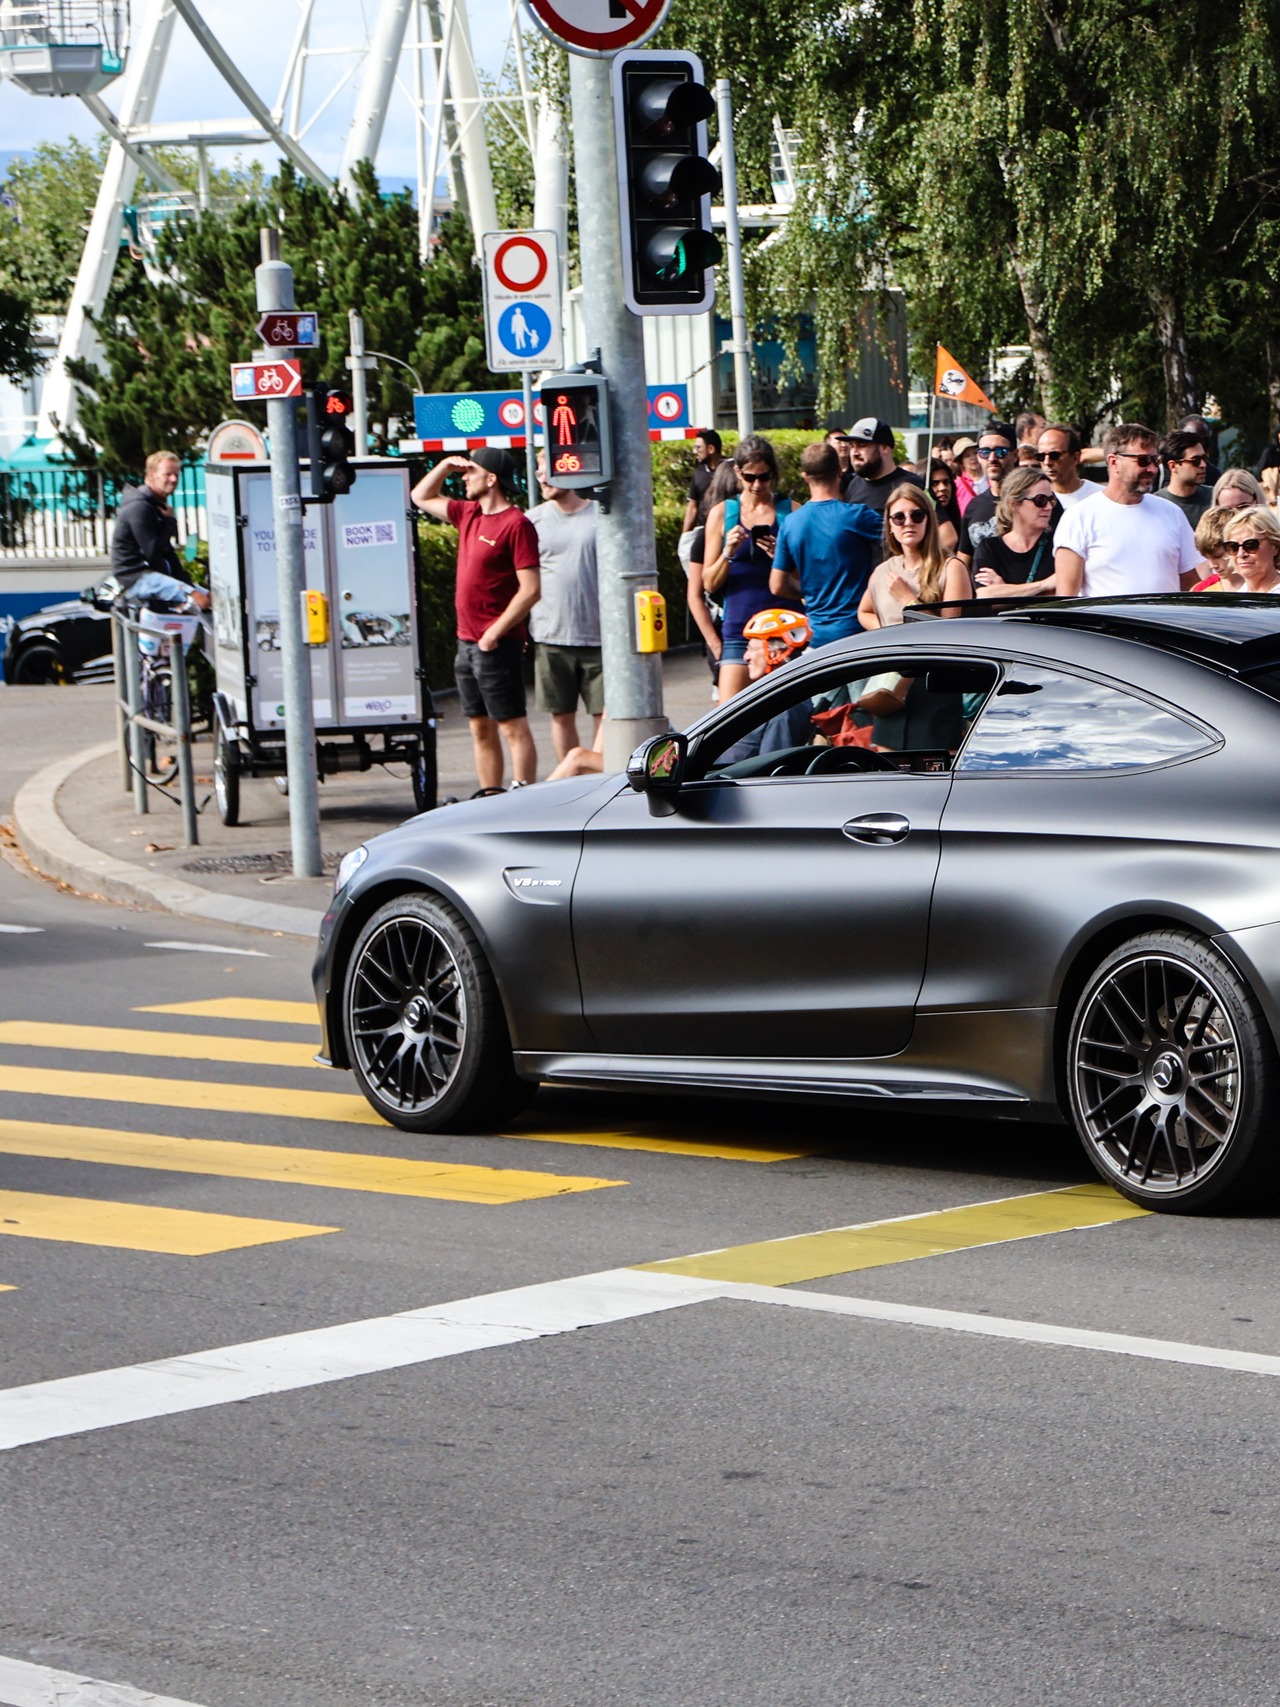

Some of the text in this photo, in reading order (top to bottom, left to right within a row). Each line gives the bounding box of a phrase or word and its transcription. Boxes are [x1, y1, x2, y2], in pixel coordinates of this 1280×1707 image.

[253, 530, 275, 541] YOU
[345, 526, 373, 537] BOOK
[346, 535, 374, 546] NOW!
[513, 877, 532, 887] V8
